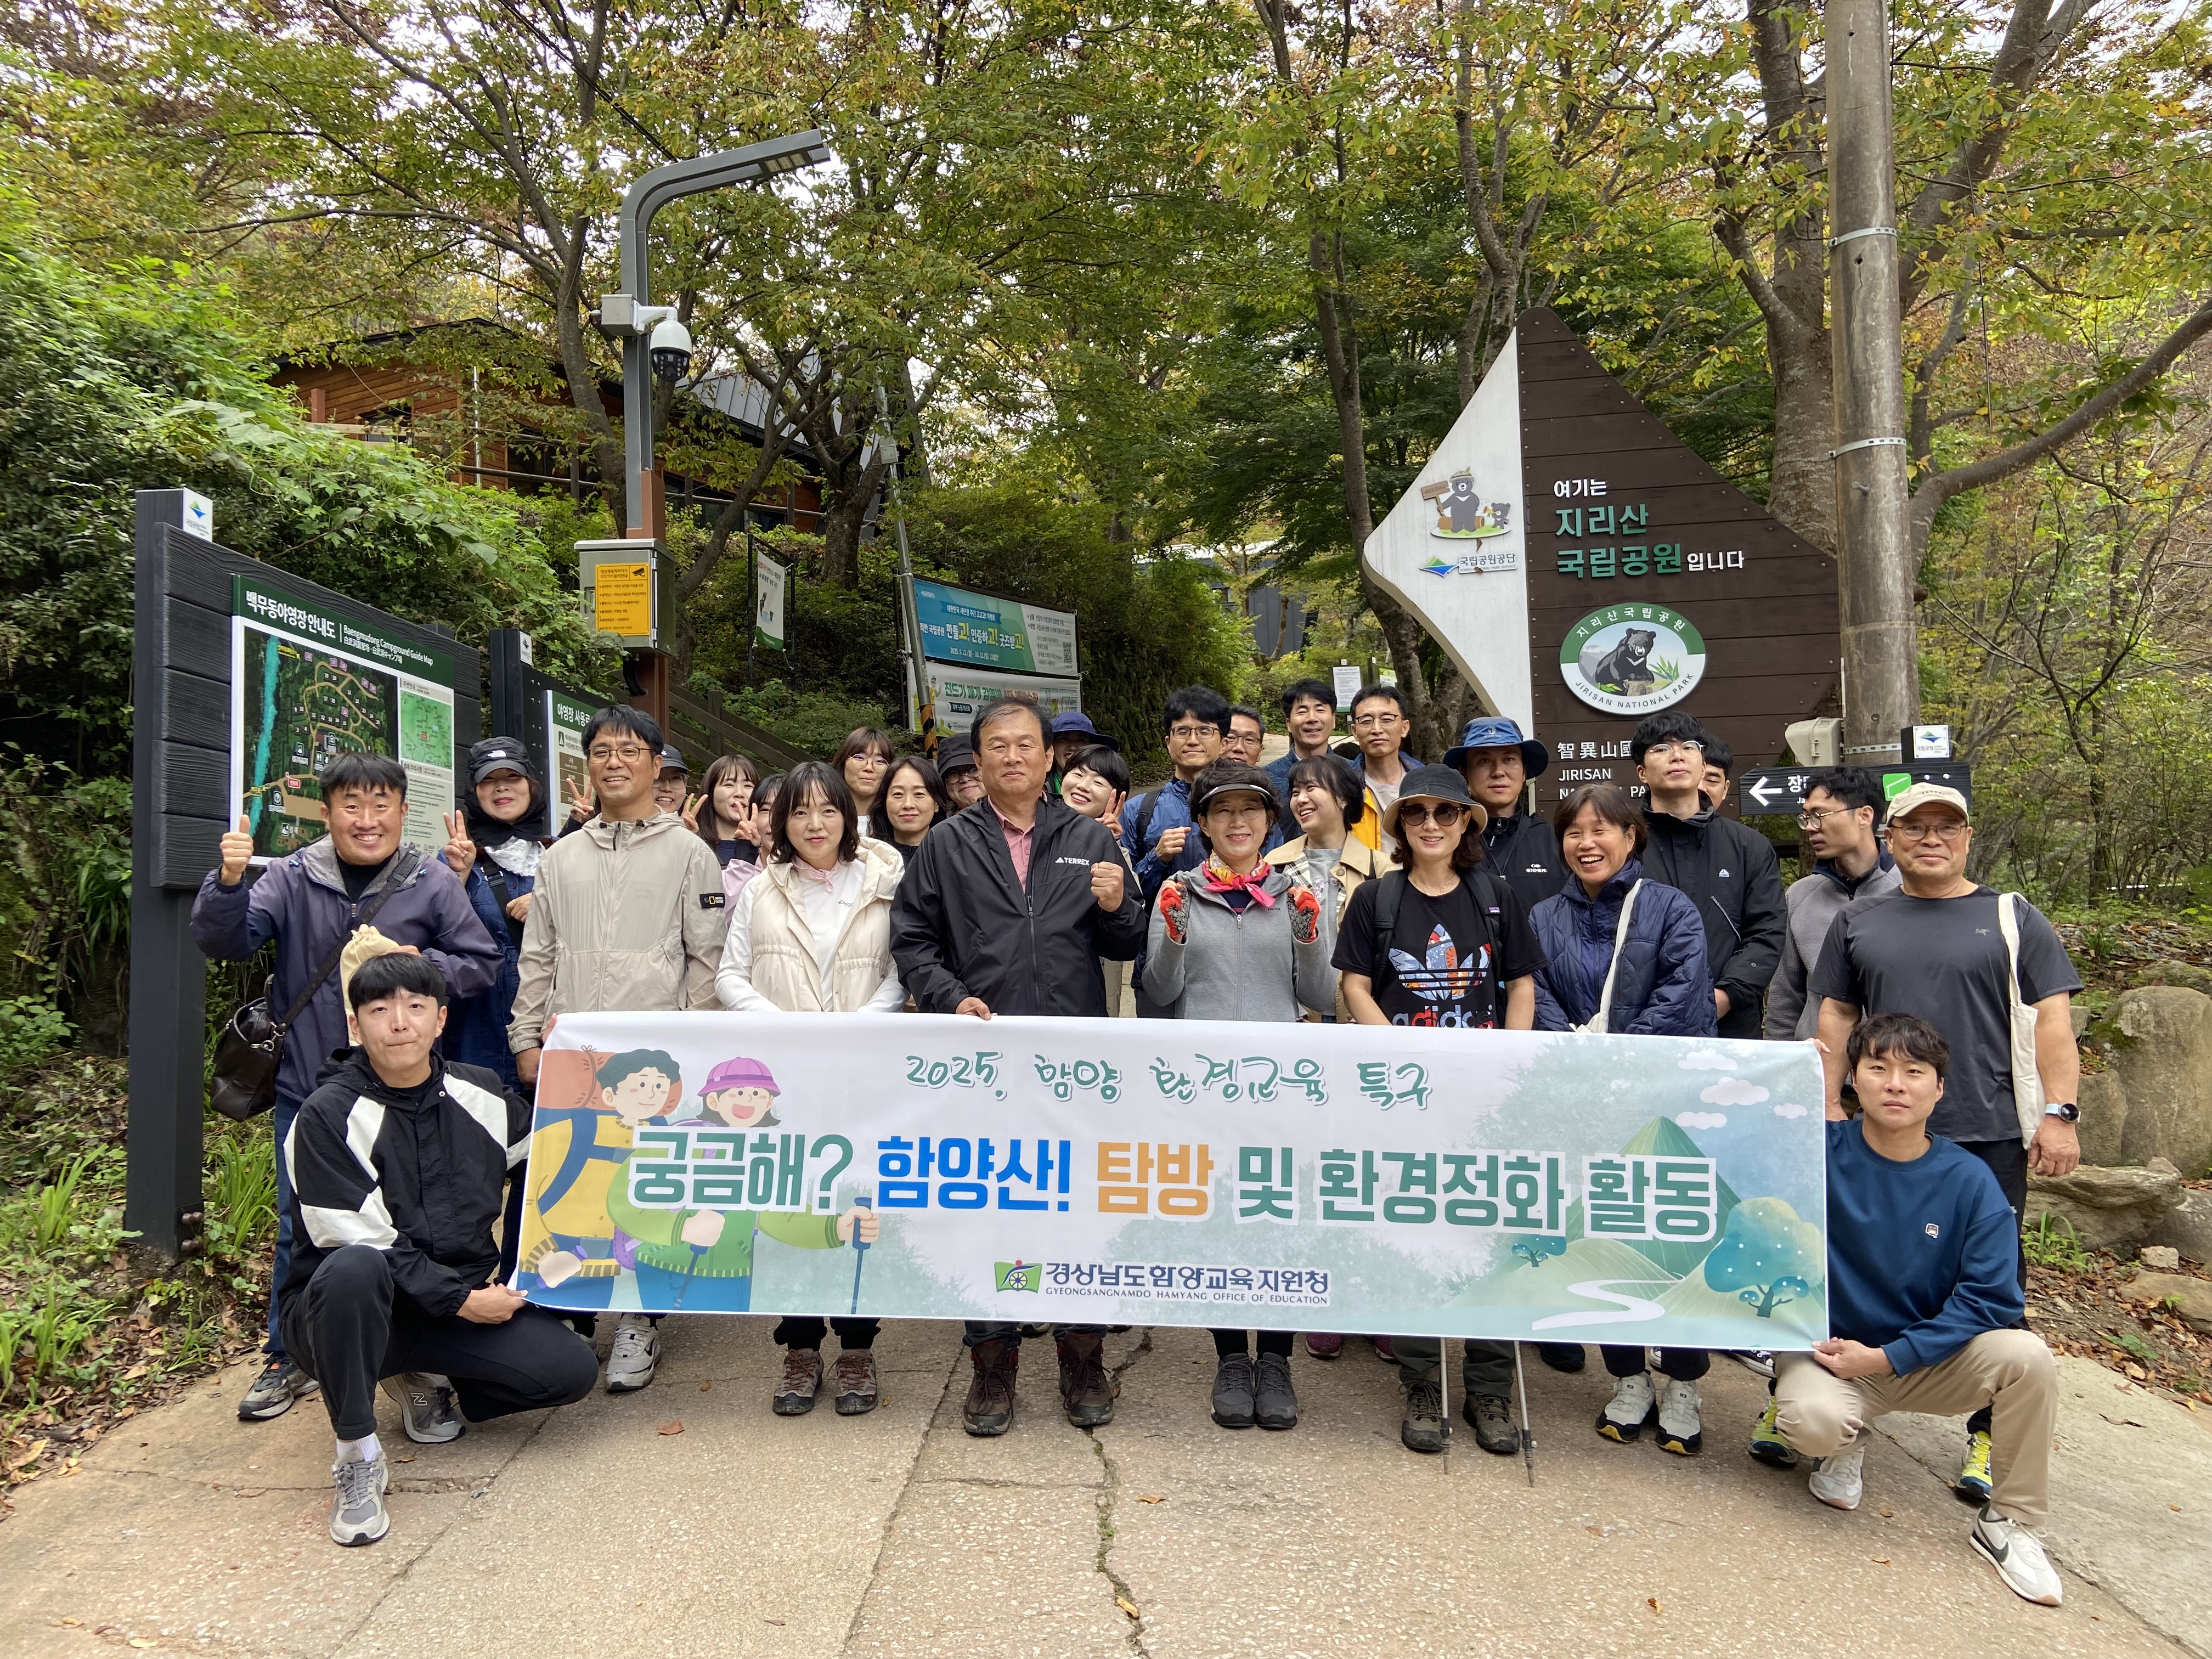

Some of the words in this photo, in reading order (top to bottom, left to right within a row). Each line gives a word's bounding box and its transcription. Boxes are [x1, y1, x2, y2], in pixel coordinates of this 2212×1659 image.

[1554, 479, 1607, 498] 여기는
[1555, 504, 1649, 537] 지리산
[1460, 553, 1516, 566] 국립공원공단
[1557, 543, 1682, 578] 국립공원
[1687, 551, 1745, 572] 입니다
[246, 591, 307, 629] 백무동야영장
[307, 614, 336, 639] 안내도
[946, 605, 960, 614] 대한민국
[1576, 607, 1686, 638] 지리산국립공원
[343, 624, 380, 648] Baengmudong
[380, 639, 410, 657] Campground
[410, 650, 424, 662] Guide
[423, 654, 433, 667] Map
[929, 624, 945, 636] 국립공원
[946, 622, 970, 642] 만들고!
[970, 628, 998, 647] 인증하고!
[999, 633, 1025, 651] 굿즈받고!
[944, 682, 966, 698] 진드기
[1576, 681, 1612, 706] JIRISAN
[1617, 693, 1671, 709] NATIONAL
[1672, 673, 1694, 695] PARK
[557, 703, 574, 723] 야영장
[1559, 768, 1611, 782] JIRISAN
[1064, 857, 1090, 866] TERREX
[1392, 1005, 1494, 1030] adidas
[906, 1052, 1003, 1097] 2025.
[1034, 1053, 1119, 1100] 함양
[1149, 1053, 1323, 1101] 환경교육
[1356, 1062, 1429, 1107] 특구
[633, 1131, 854, 1209] 궁금해?
[877, 1136, 1069, 1212] 함양산!
[1097, 1141, 1214, 1216] 탐방
[1238, 1146, 1296, 1220] 및
[1319, 1148, 1565, 1230] 환경정화
[1588, 1159, 1712, 1241] 활동
[1046, 1287, 1151, 1298] GYEONGSANGNAMDO
[1156, 1290, 1207, 1300] HAMYANG
[1213, 1293, 1245, 1301] OFFICE
[1251, 1294, 1264, 1302] OF
[1270, 1295, 1328, 1304] EDUCATION
